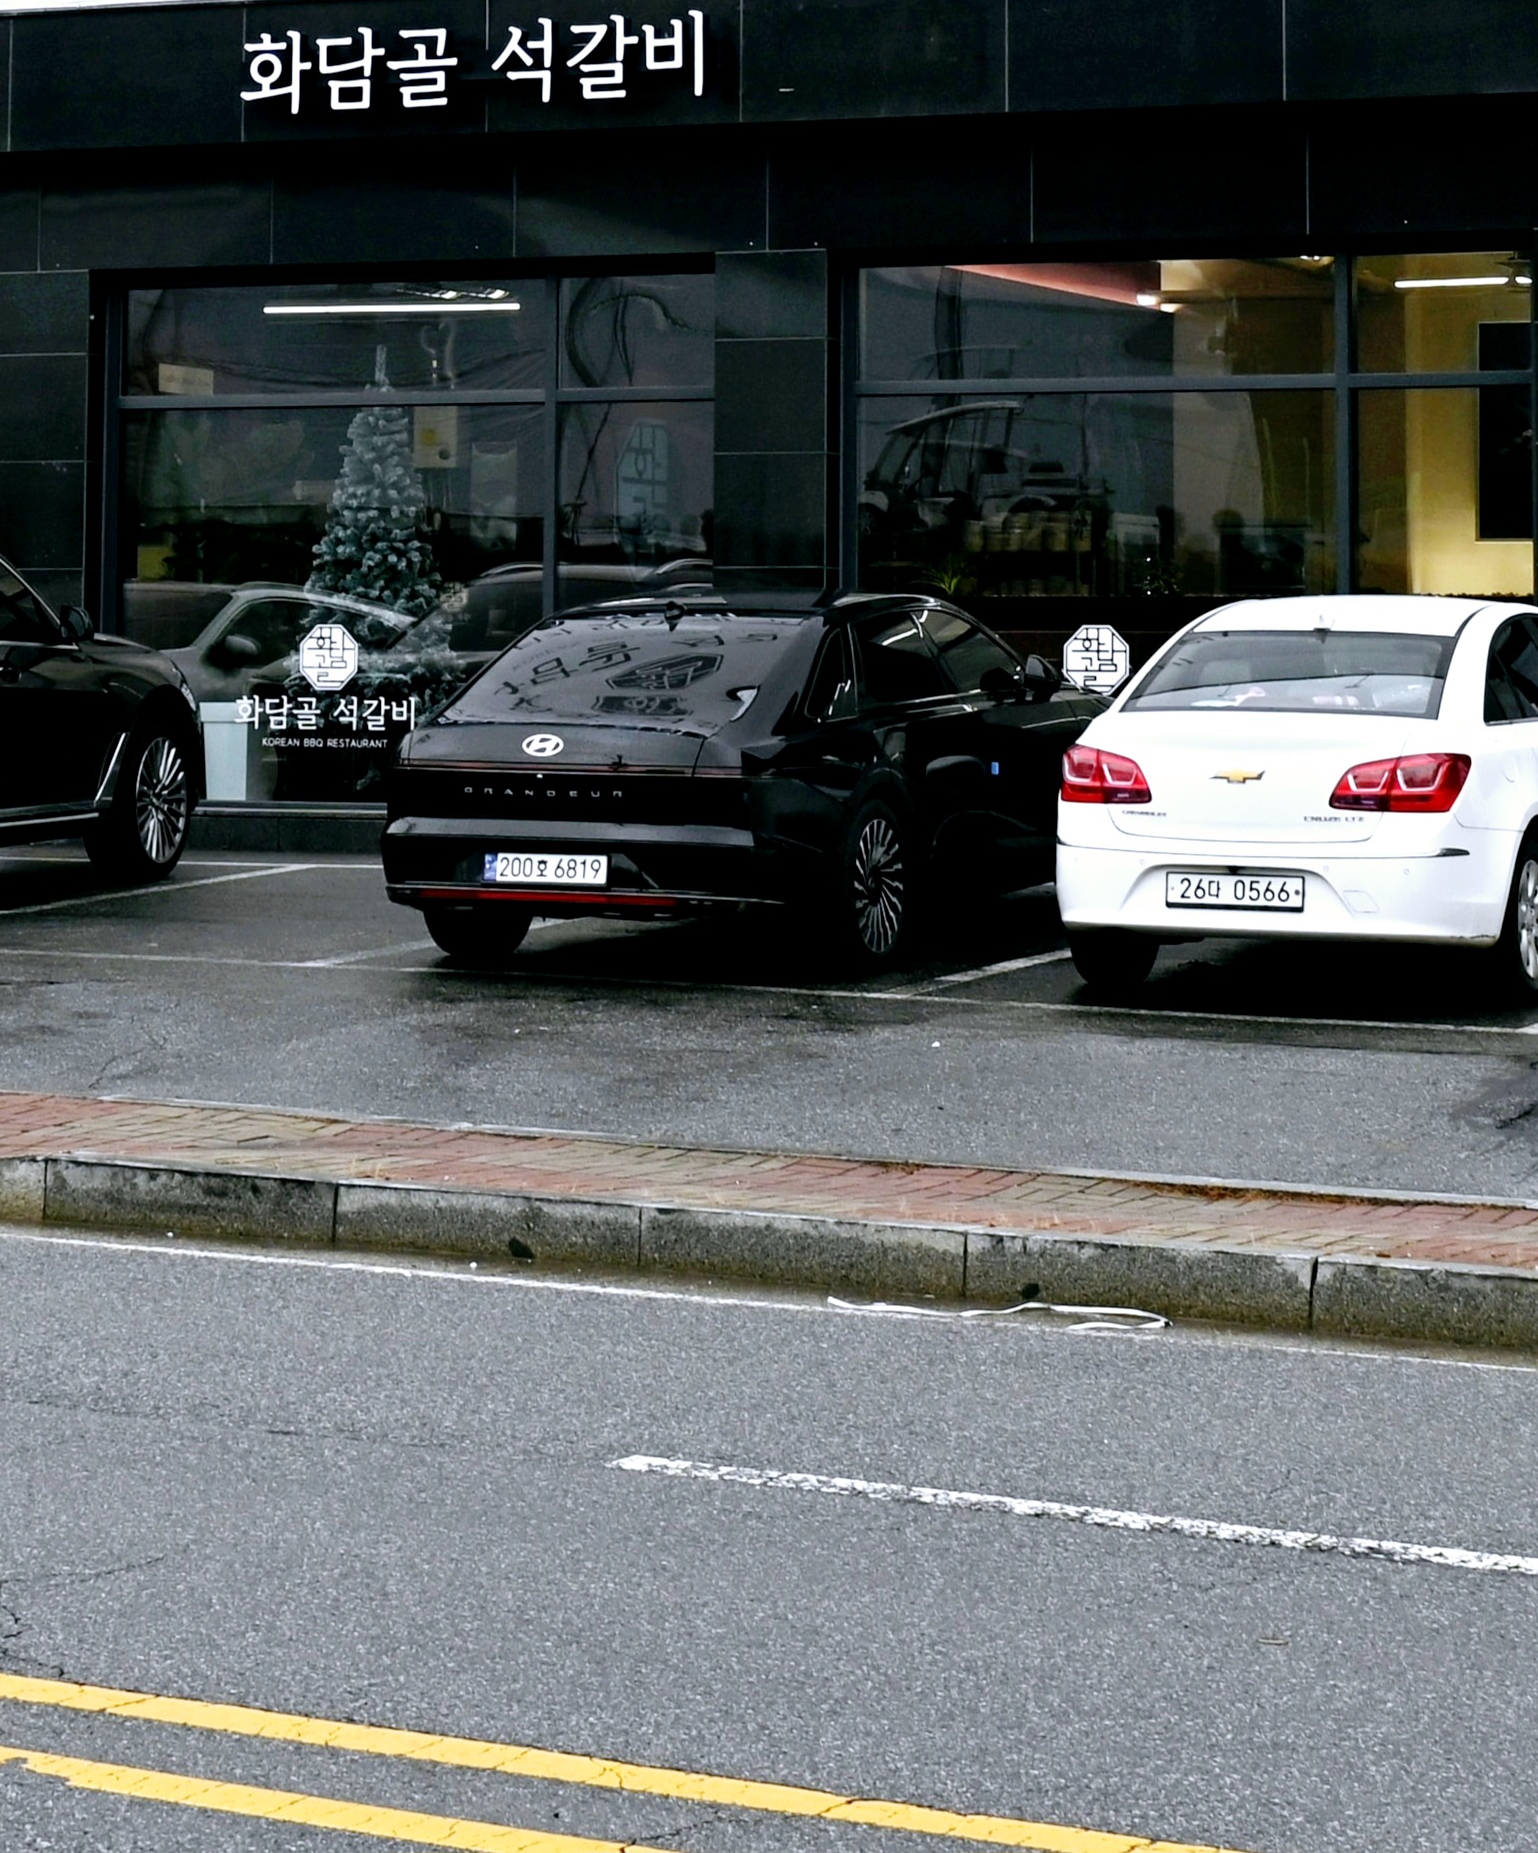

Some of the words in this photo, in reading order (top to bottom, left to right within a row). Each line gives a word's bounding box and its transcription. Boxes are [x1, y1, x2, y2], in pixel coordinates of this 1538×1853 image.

[239, 25, 459, 115] 화담골
[491, 9, 706, 103] 석갈비
[235, 695, 322, 730] 화담골
[333, 695, 416, 731] 석갈비
[262, 737, 300, 747] KOREAN
[303, 738, 323, 747] BBQ
[327, 738, 388, 748] RESTAURANT
[464, 786, 623, 798] GRANDEUR
[499, 856, 548, 878] 200호
[554, 858, 602, 880] 6819
[1180, 877, 1221, 900] 26다
[1233, 878, 1291, 903] 0566
